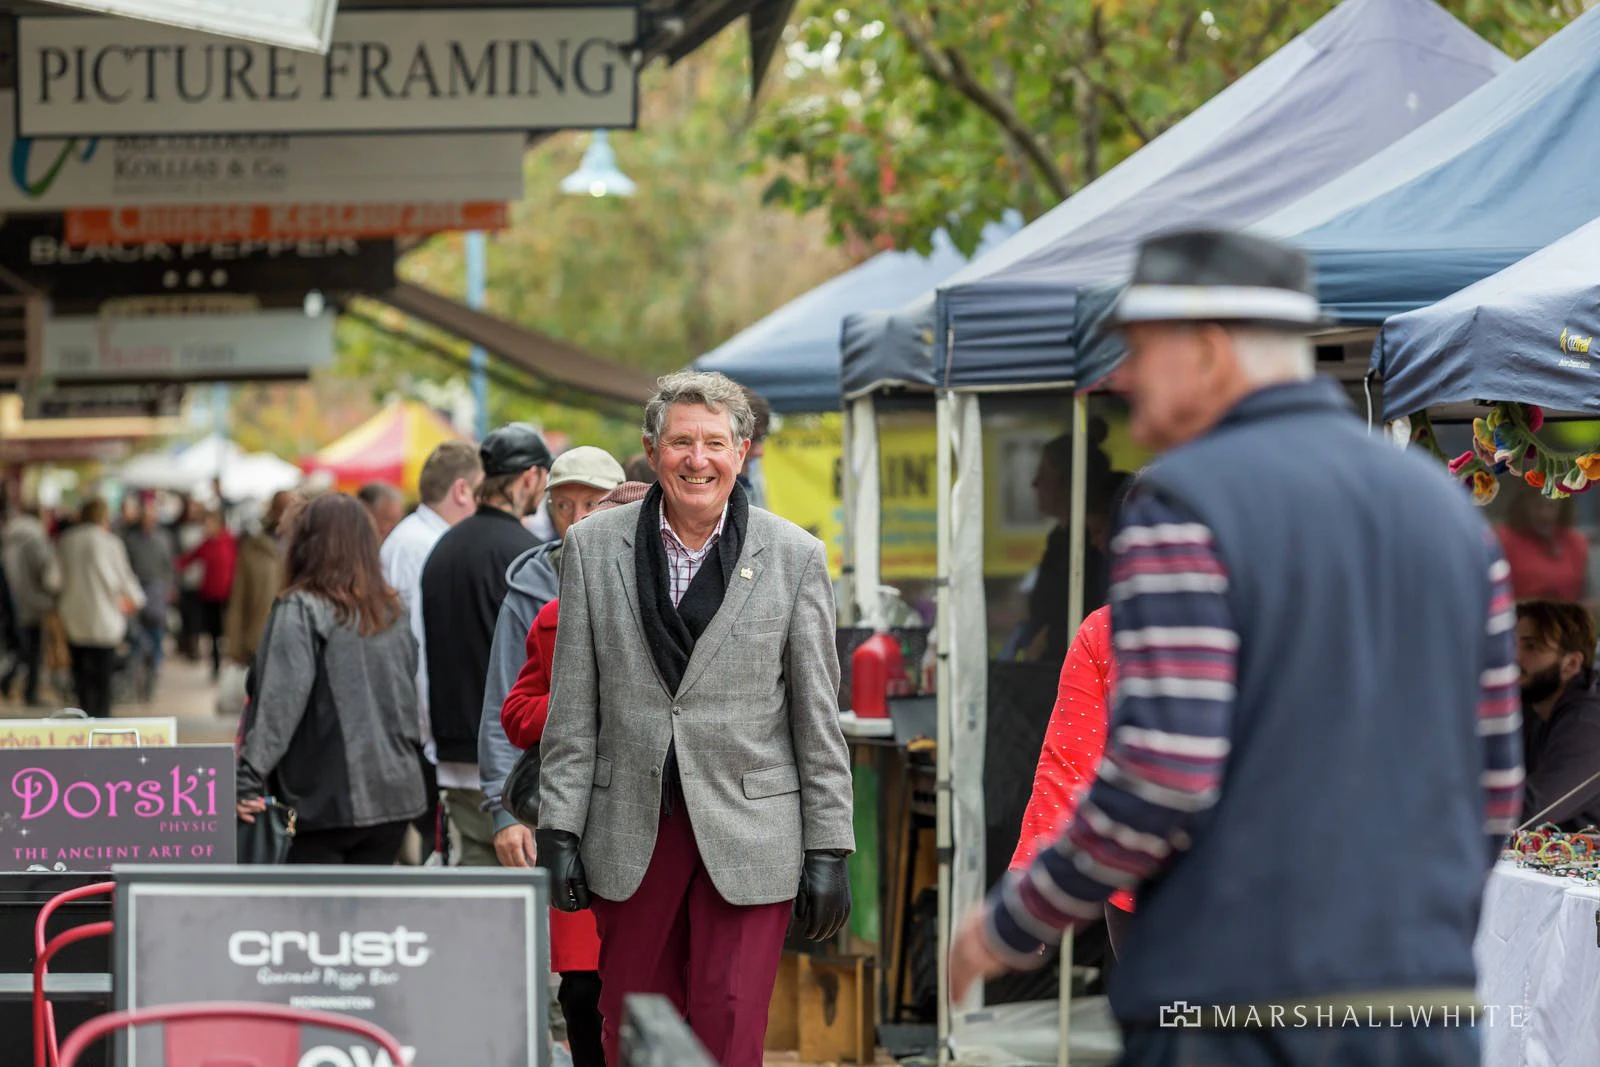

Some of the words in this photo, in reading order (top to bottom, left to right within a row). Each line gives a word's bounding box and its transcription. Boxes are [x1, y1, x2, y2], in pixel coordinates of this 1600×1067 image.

[37, 44, 301, 105] PICTURE
[322, 37, 617, 98] FRAMING
[11, 764, 219, 820] Dorski
[159, 819, 218, 833] PHYSIC
[13, 847, 49, 860] THE
[56, 846, 141, 859] ANCIENT
[148, 845, 184, 858] ART
[191, 844, 215, 857] OF
[228, 924, 430, 967] crust
